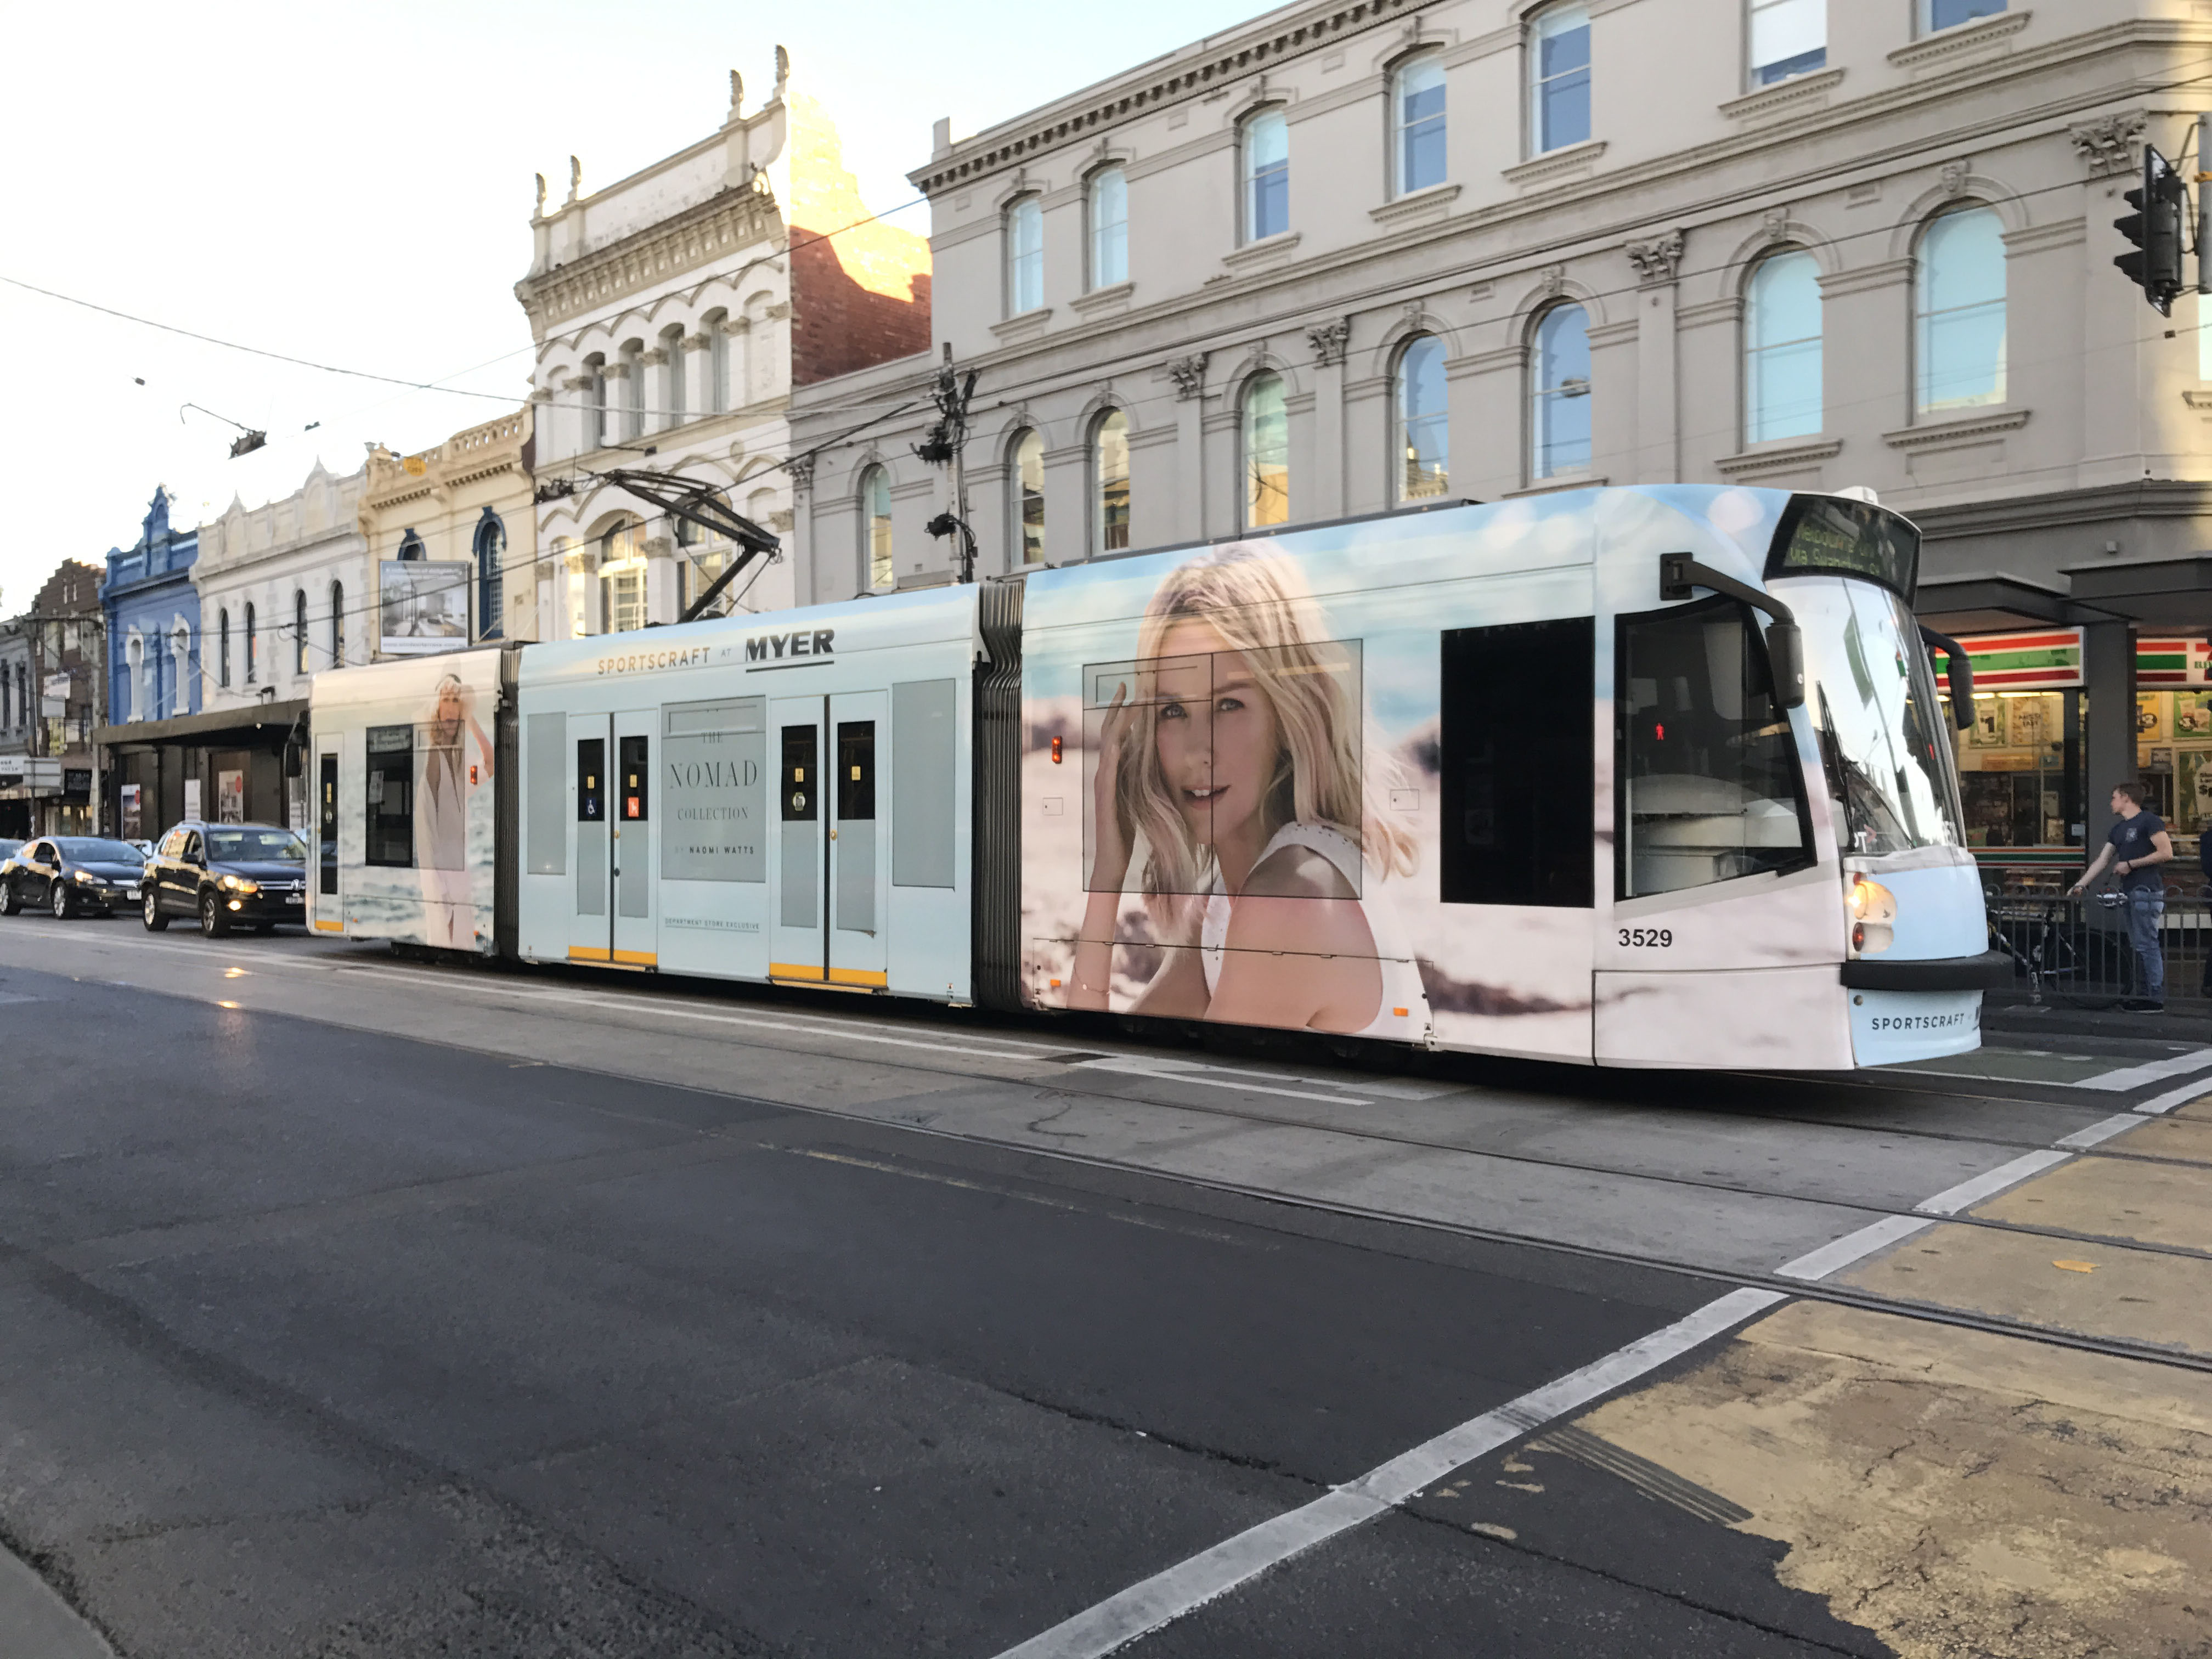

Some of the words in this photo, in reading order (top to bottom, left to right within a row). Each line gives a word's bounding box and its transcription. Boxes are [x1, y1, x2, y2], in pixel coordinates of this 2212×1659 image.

[598, 646, 711, 675] SPORTSCRAFT
[721, 648, 731, 657] AT
[746, 629, 835, 662] MYER
[701, 731, 723, 744] THE
[669, 759, 757, 789] NOMAD
[678, 806, 748, 821] COLLECTION
[690, 846, 719, 854] NAOMI
[724, 845, 754, 854] WATTS
[664, 917, 702, 926] DEPARTMENT
[726, 922, 760, 930] EXCLUSIVE
[1618, 928, 1673, 947] 3529
[1871, 1013, 1965, 1030] SPORTSCRAFT
